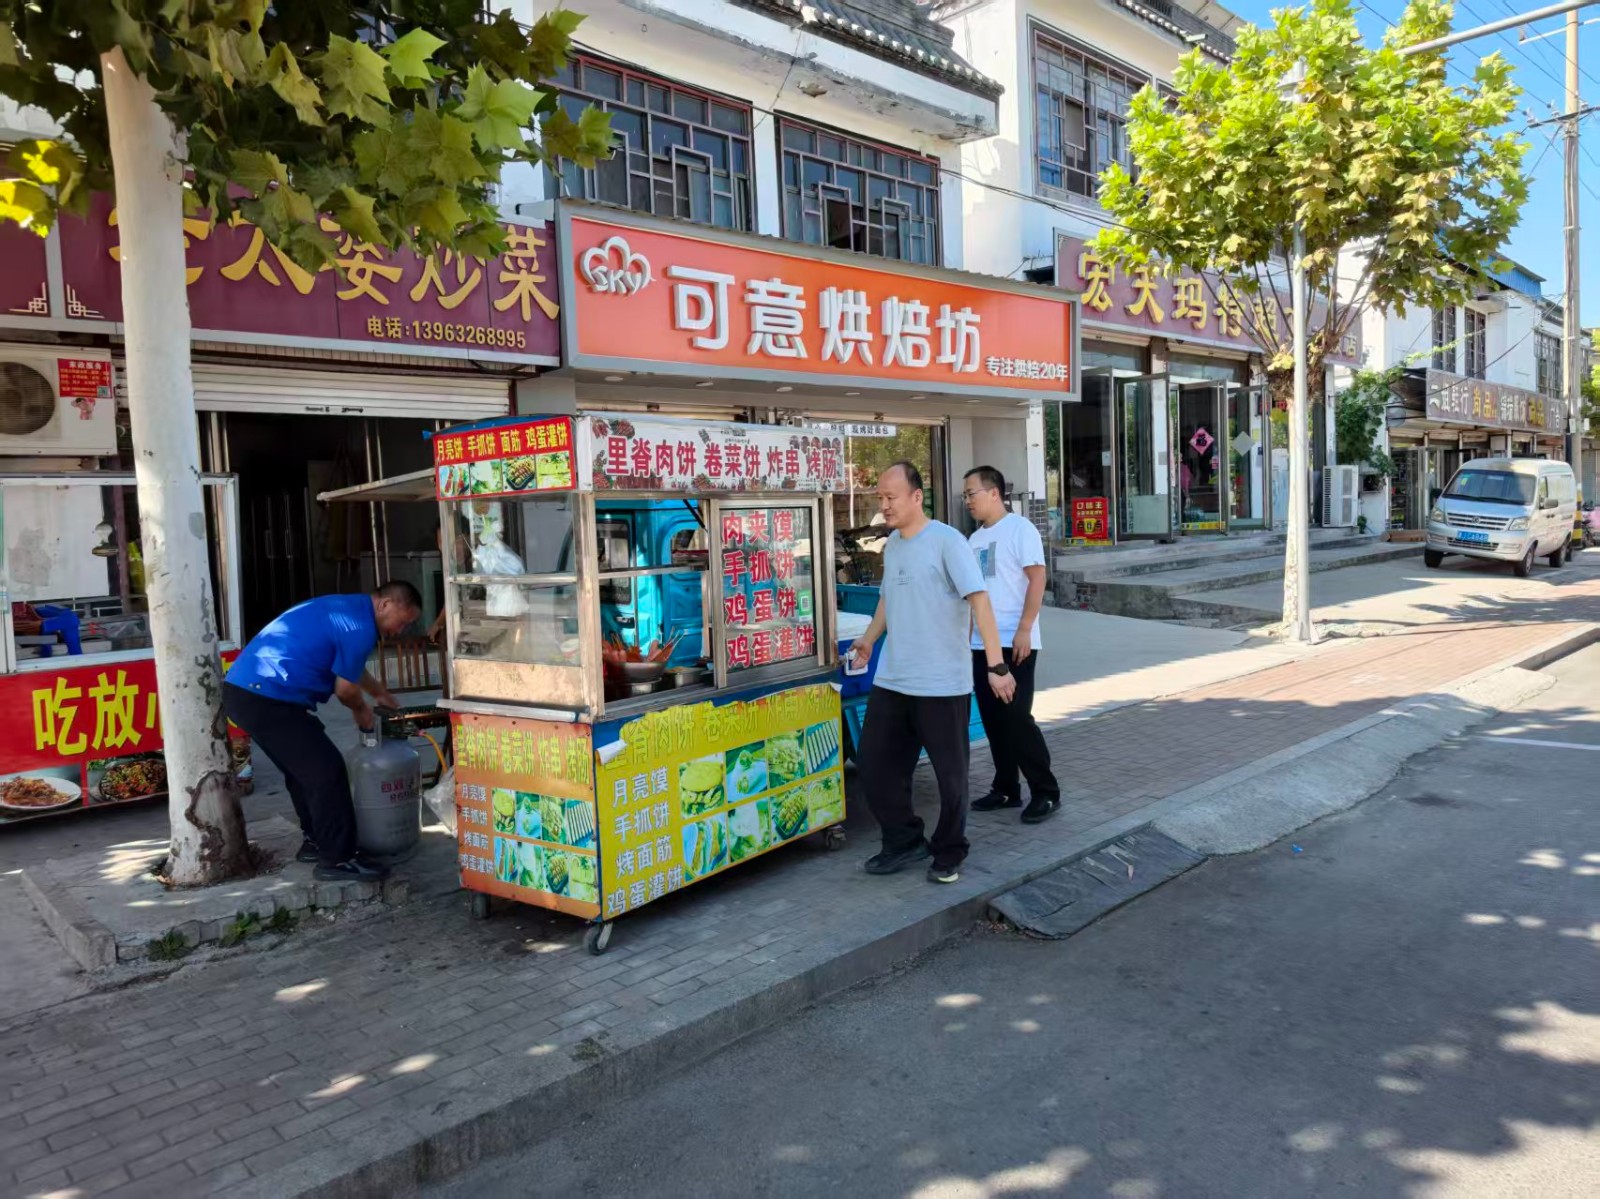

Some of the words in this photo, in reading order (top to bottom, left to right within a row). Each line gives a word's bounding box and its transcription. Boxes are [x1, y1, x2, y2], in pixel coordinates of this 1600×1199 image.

[667, 264, 982, 374] 可意烘焙坊
[985, 356, 1068, 382] 专注烘焙20年
[467, 432, 496, 458] 手抓饼
[500, 429, 522, 454] 面筋
[525, 422, 568, 451] 鸡蛋灌饼
[606, 436, 697, 478] 里脊肉饼
[703, 441, 761, 479] 卷菜饼
[766, 445, 801, 480] 炸串
[805, 447, 838, 480] 烤肠
[721, 510, 795, 547] 肉夹馍
[723, 549, 797, 587] 手抓饼
[724, 586, 798, 627] 鸡蛋饼
[726, 623, 816, 669] 鸡蛋灌饼
[613, 766, 669, 809] 月亮馍
[462, 807, 488, 827] 手抓饼
[614, 801, 670, 844] 手抓饼
[463, 830, 489, 851] 烤面筋
[616, 835, 673, 880] 烤面筋
[607, 863, 684, 915] 鸡蛋灌饼
